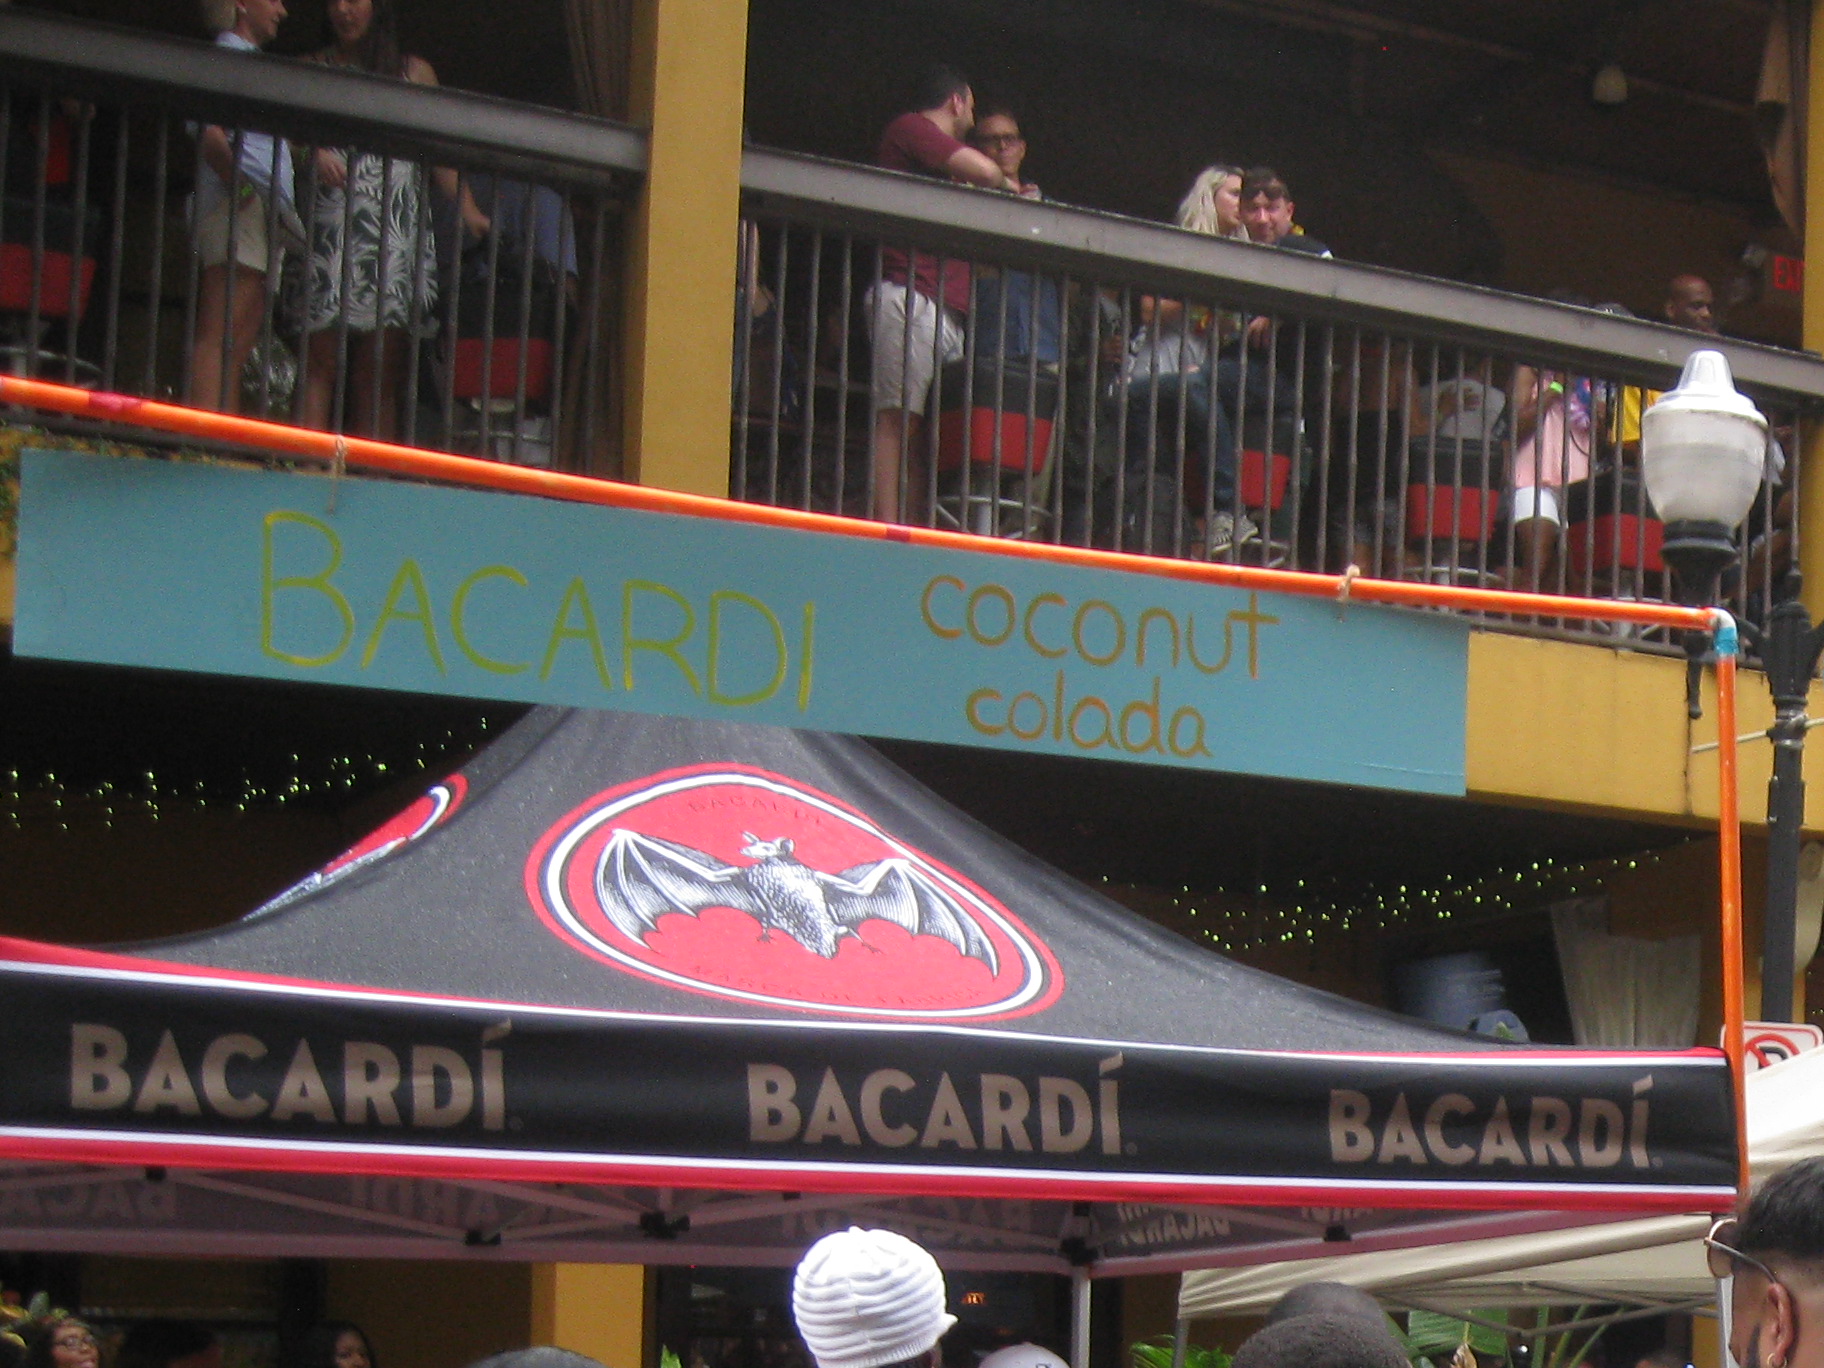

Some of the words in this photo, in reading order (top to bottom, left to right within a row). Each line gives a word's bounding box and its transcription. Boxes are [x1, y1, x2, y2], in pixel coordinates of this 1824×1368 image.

[261, 510, 816, 713] BACARDI
[920, 573, 1281, 681] coconut
[965, 669, 1212, 758] colada
[70, 1017, 512, 1131] BACARDÍ
[746, 1050, 1124, 1155] BACARDÍ
[1328, 1075, 1655, 1169] BACARDÍ
